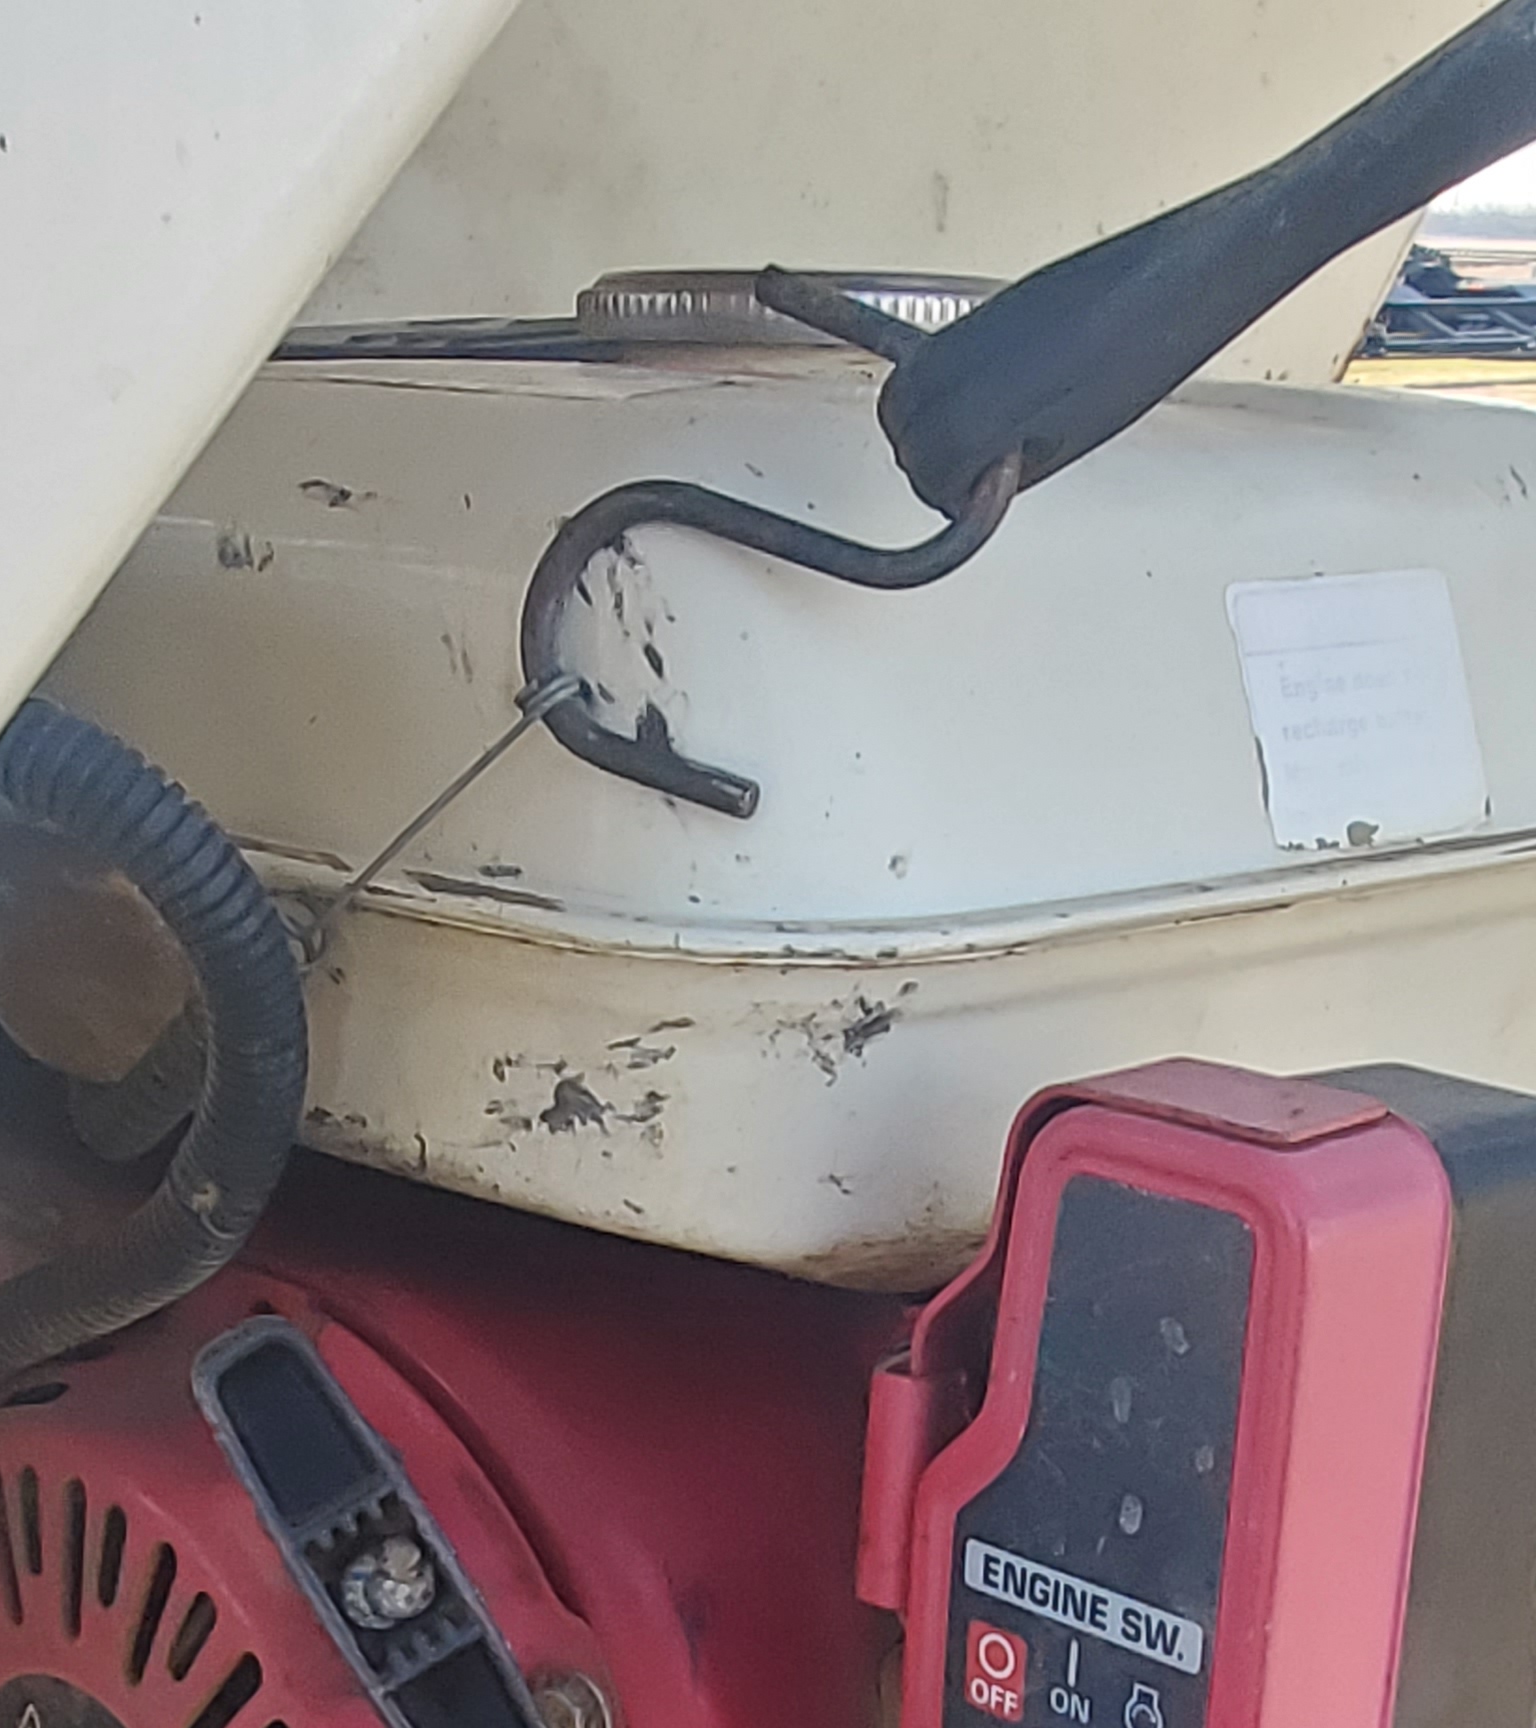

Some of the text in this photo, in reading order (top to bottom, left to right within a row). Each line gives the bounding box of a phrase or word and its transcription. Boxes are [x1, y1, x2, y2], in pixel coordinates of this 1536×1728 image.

[982, 1552, 1185, 1662] ENGINE SW.
[970, 1678, 1018, 1715] OFF
[1049, 1687, 1091, 1724] ON
